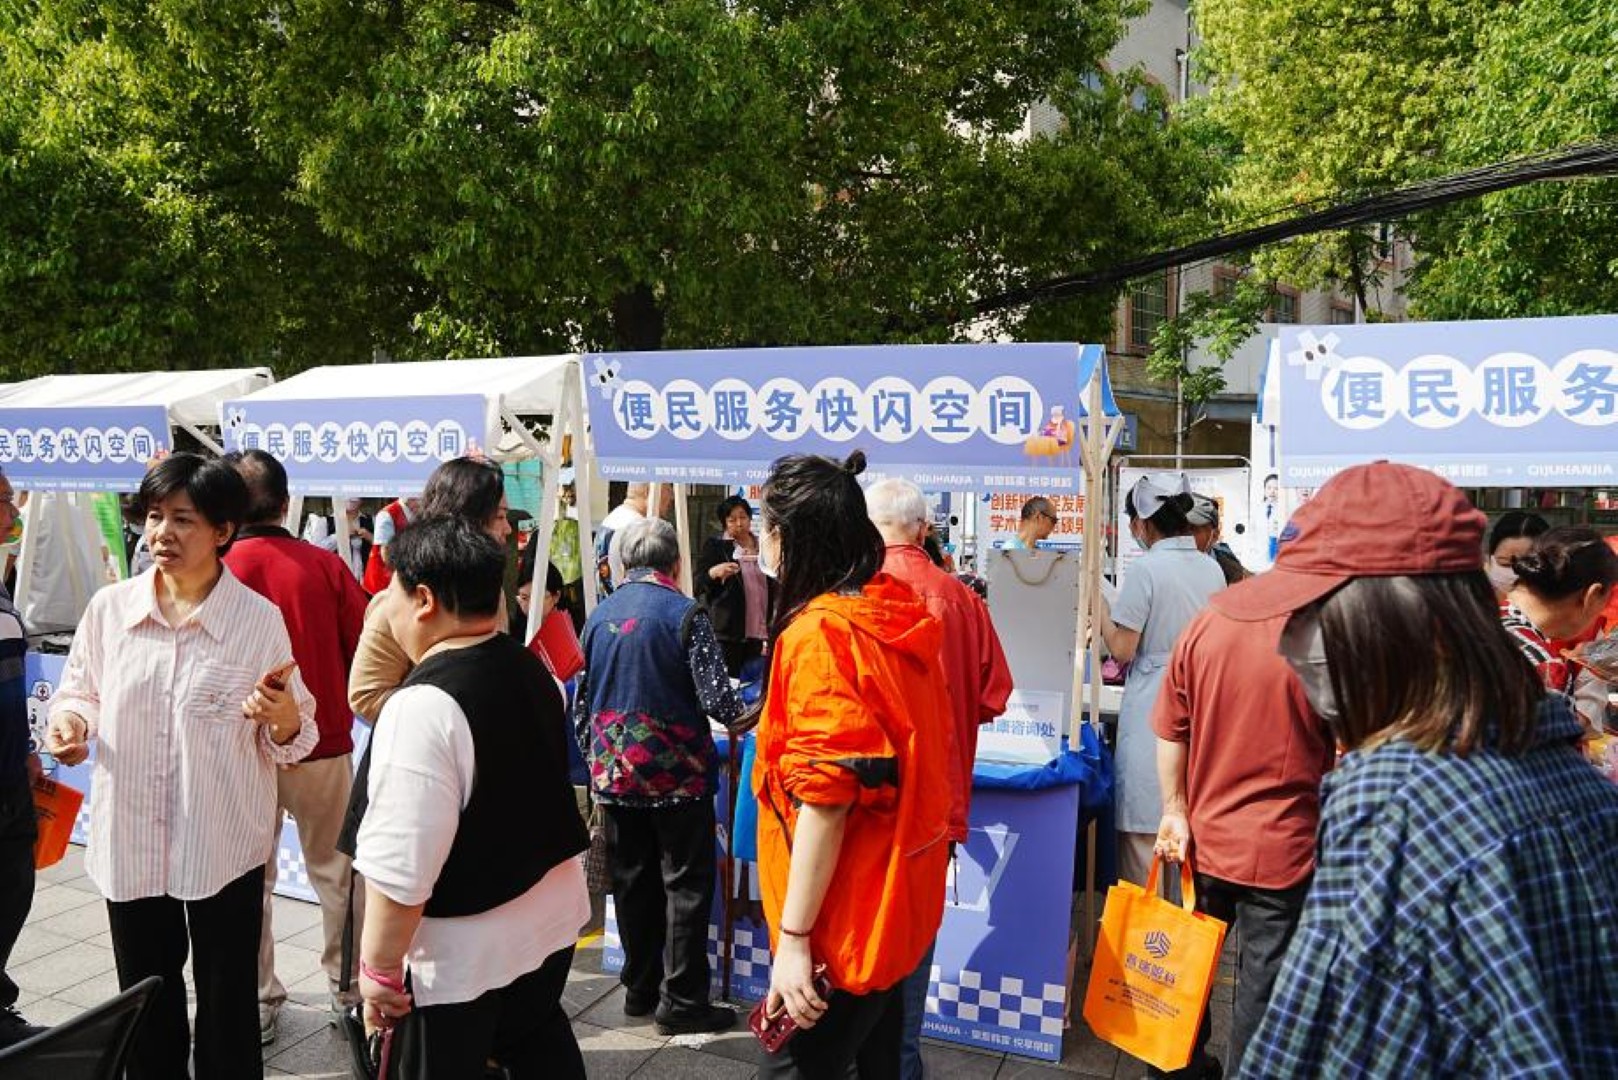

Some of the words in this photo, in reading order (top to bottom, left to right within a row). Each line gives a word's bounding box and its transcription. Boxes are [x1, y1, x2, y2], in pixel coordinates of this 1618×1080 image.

[619, 389, 1031, 435] 便民服务快闪空间
[1331, 362, 1618, 419] 便民服务
